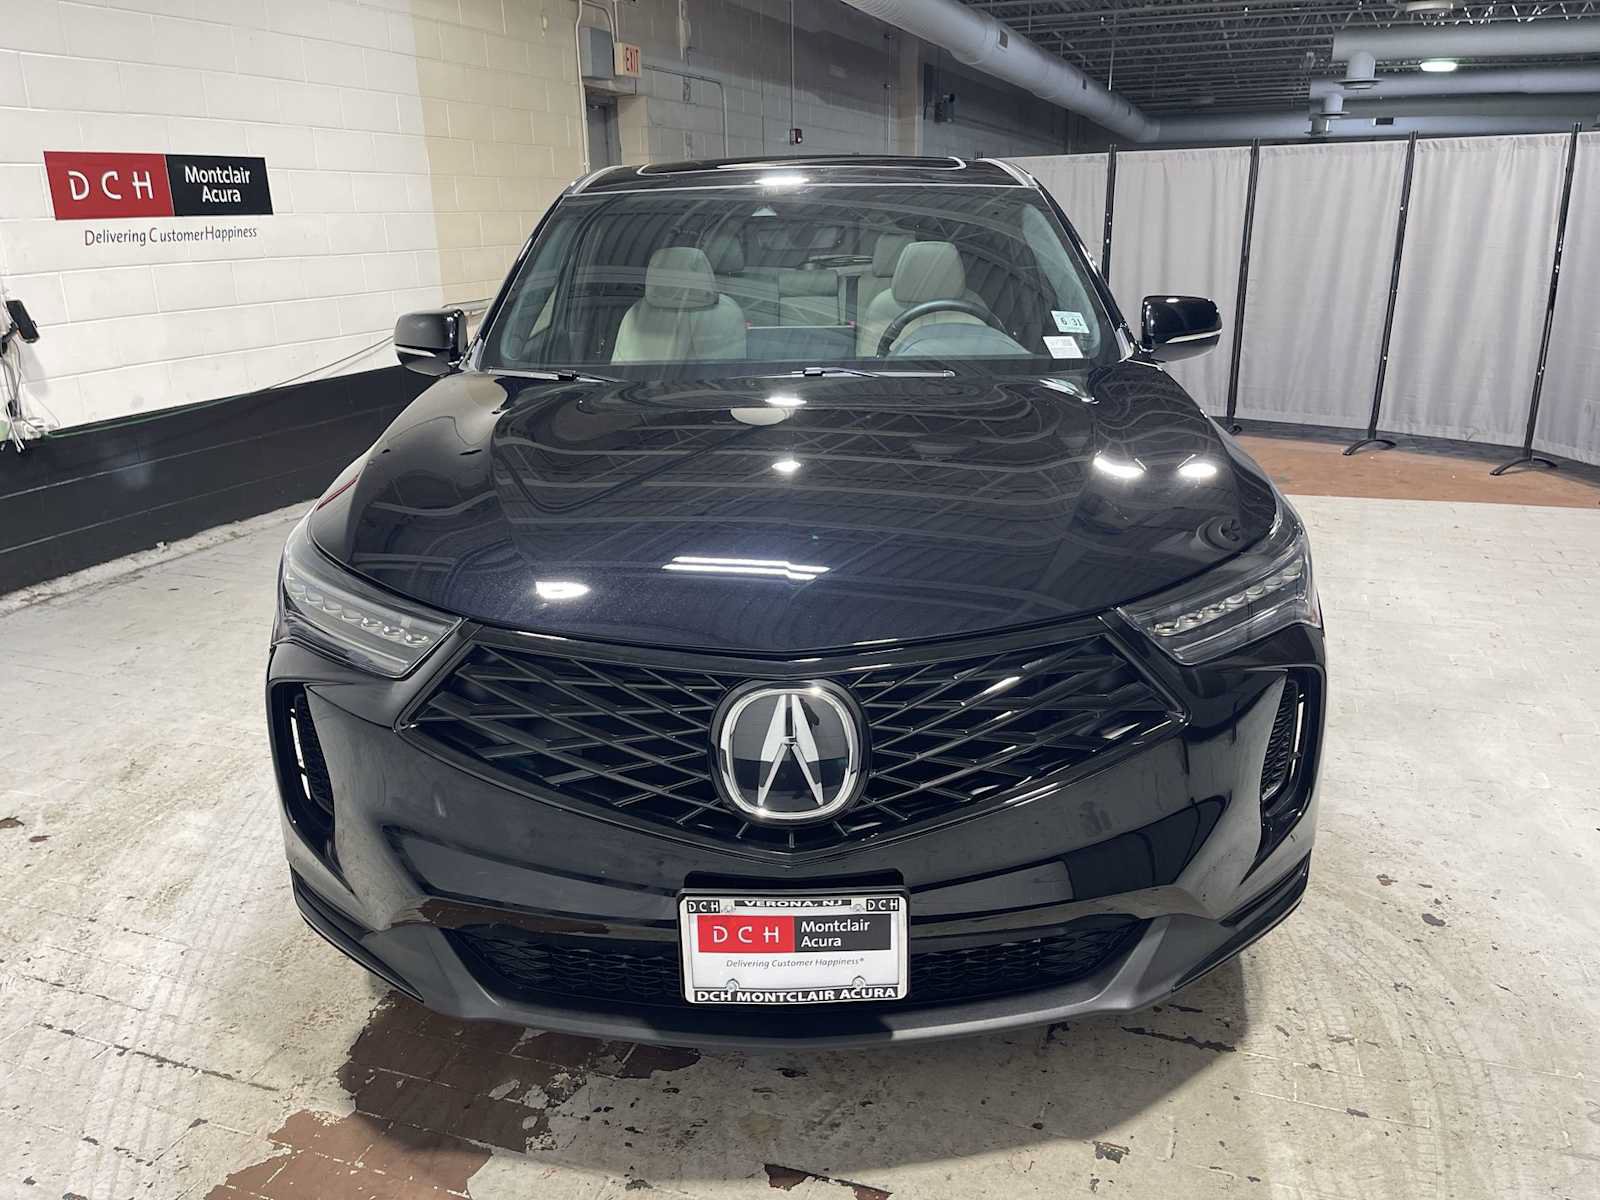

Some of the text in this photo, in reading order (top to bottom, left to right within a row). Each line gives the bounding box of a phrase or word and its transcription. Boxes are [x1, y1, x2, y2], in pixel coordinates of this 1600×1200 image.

[626, 47, 639, 73] EXIT
[184, 165, 251, 185] Montclair
[67, 170, 153, 200] DCH
[201, 185, 242, 203] Acura
[84, 228, 146, 246] Delivering
[204, 225, 257, 243] Happiness
[687, 901, 720, 913] DCH
[867, 899, 899, 911] DCH
[801, 919, 871, 932] Montclair
[712, 925, 780, 944] DCH
[800, 935, 842, 948] Acura
[726, 959, 770, 969] Delivering
[771, 959, 813, 968] Customer
[697, 987, 897, 1003] DCH MONTCLAIR ACURA
